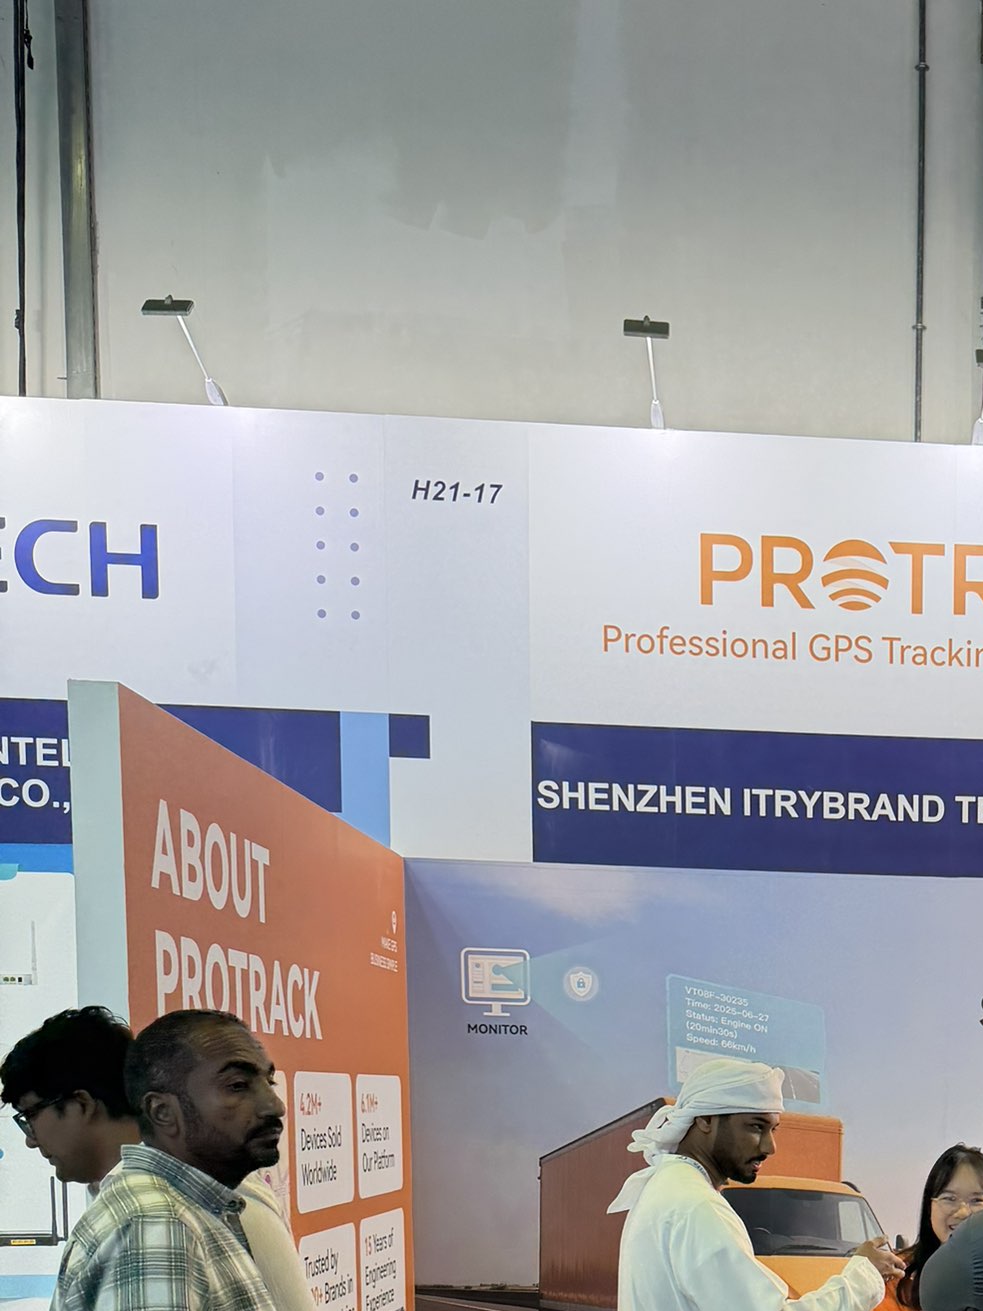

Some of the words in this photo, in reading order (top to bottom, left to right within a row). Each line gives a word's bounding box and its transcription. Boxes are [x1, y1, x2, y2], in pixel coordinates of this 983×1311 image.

[411, 479, 503, 504] H21-17
[0, 516, 159, 600] CH
[602, 624, 797, 661] Professional
[808, 633, 873, 664] GPS
[536, 780, 731, 816] SHENZHEN
[743, 788, 945, 823] ITRYBRAND
[151, 798, 270, 923] ABOUT
[155, 929, 323, 1040] PROTRACK
[685, 998, 711, 1011] Time:
[467, 1023, 528, 1036] MONITOR
[685, 1010, 718, 1024] Status:
[721, 1017, 751, 1031] Engine
[754, 1023, 768, 1034] ON
[686, 1034, 718, 1047] Speed:
[301, 1127, 327, 1151] Devices
[328, 1125, 342, 1148] Sold
[362, 1122, 382, 1143] Devices
[383, 1126, 389, 1141] on
[301, 1159, 337, 1186] Worldwide
[362, 1152, 373, 1173] Our
[374, 1149, 395, 1171] Platform
[373, 1233, 387, 1254] Years
[388, 1227, 394, 1248] of
[304, 1248, 329, 1280] Trusted
[330, 1247, 338, 1275] by
[365, 1257, 396, 1289] Engineering
[324, 1274, 346, 1305] Brands
[347, 1274, 353, 1294] in
